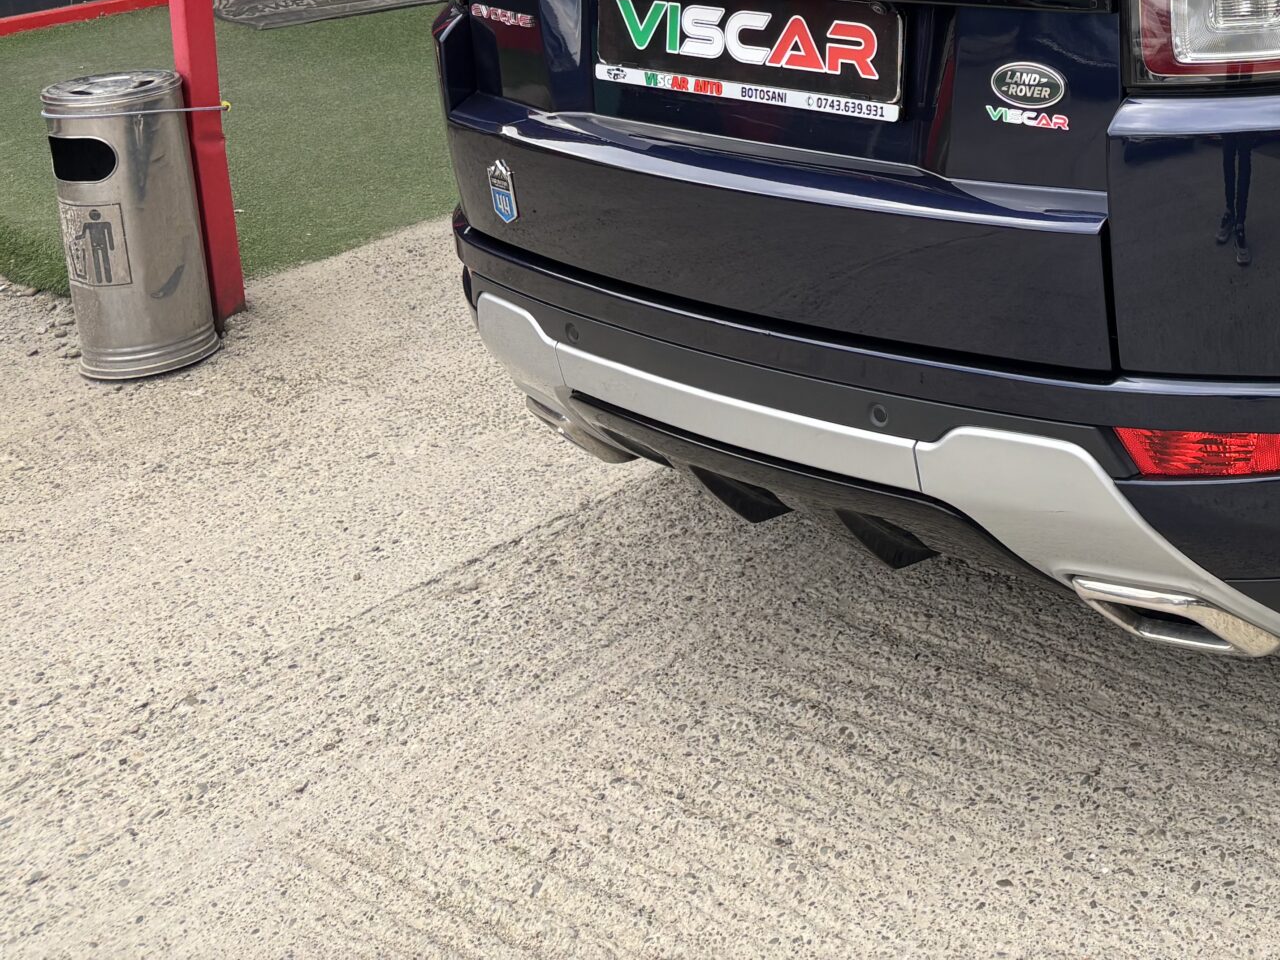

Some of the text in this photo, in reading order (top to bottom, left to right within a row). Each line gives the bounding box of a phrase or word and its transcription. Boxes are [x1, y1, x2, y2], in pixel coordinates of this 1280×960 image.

[471, 3, 535, 27] EVOQUE
[1005, 71, 1040, 85] LAND
[644, 71, 885, 118] VISCAR AUTO BOTOSANI 0743.639.931
[1008, 84, 1051, 99] ROVER
[985, 105, 1069, 131] VISCAR
